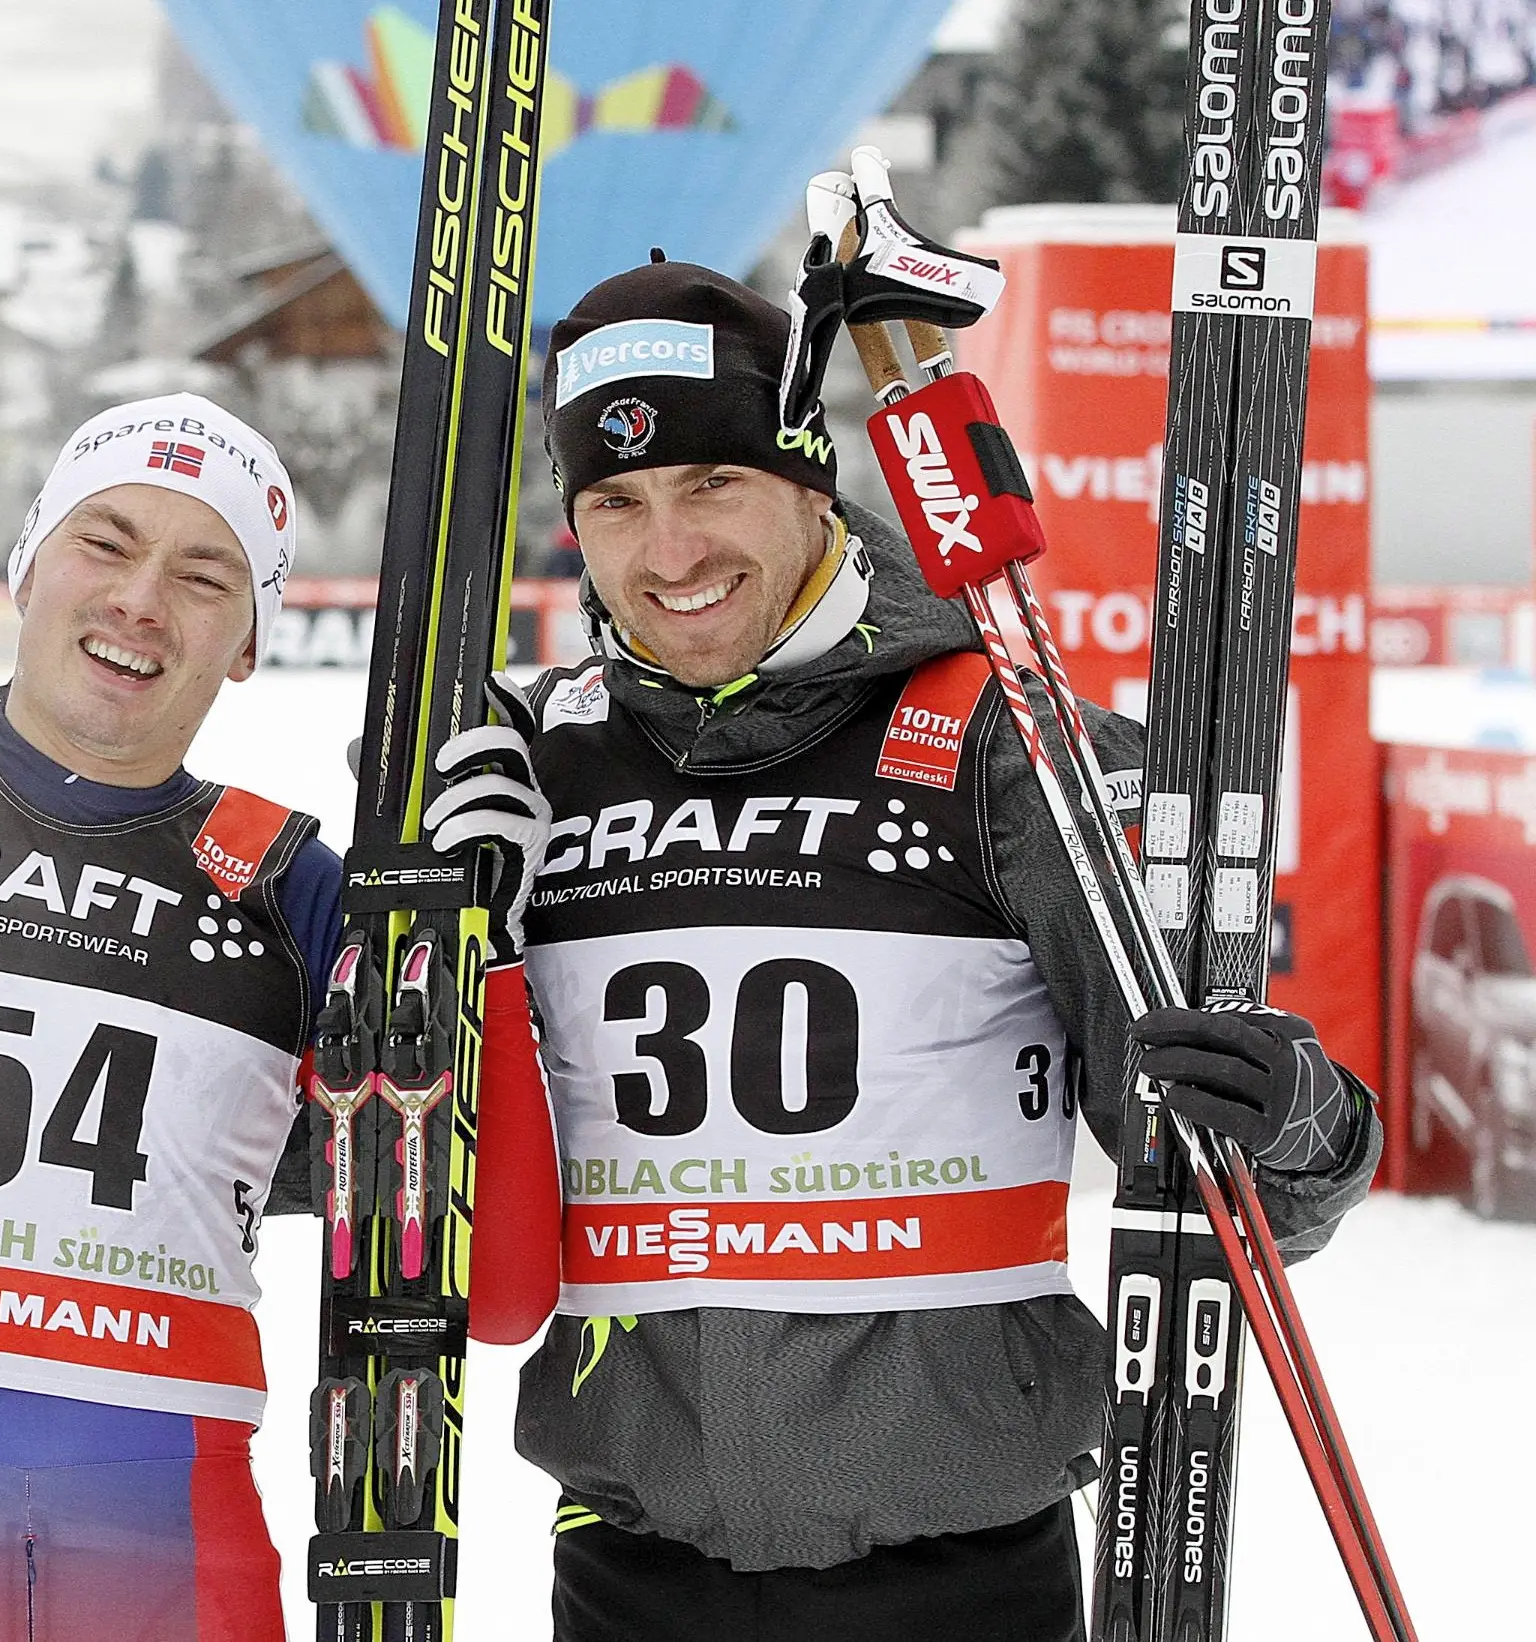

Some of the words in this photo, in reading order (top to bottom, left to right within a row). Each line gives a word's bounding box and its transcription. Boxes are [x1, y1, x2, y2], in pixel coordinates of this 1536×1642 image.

[888, 255, 963, 285] swix
[1191, 293, 1291, 312] salomon
[579, 340, 708, 374] Vercors
[74, 418, 264, 487] SpareBank
[886, 412, 983, 557] swix
[1172, 473, 1186, 543] SKATE
[1245, 475, 1259, 545] SKATE
[1189, 482, 1206, 551] LAB
[1260, 484, 1277, 552] LAB
[1167, 544, 1182, 629] CARBON
[1240, 547, 1255, 631] CARBON
[449, 679, 464, 740] EDMAX
[901, 706, 962, 736] 10TH
[888, 727, 959, 752] EDITION
[881, 764, 948, 784] #tourdeski
[1104, 778, 1142, 801] DUA
[537, 797, 861, 876] CRAFT
[1062, 826, 1091, 874] TRIAC
[1103, 803, 1129, 850] TRIAC
[204, 835, 254, 875] 10TH
[528, 875, 644, 907] UNCTIONAL
[650, 867, 822, 890] SPORTSWEAR
[603, 957, 859, 1137] 30
[563, 1158, 747, 1196] OBLACH
[584, 1208, 922, 1274] VIESSMANN
[1132, 1308, 1142, 1341] SNS
[1202, 1313, 1212, 1346] SNS
[1115, 1446, 1139, 1579] salomon
[1184, 1451, 1209, 1584] salomon
